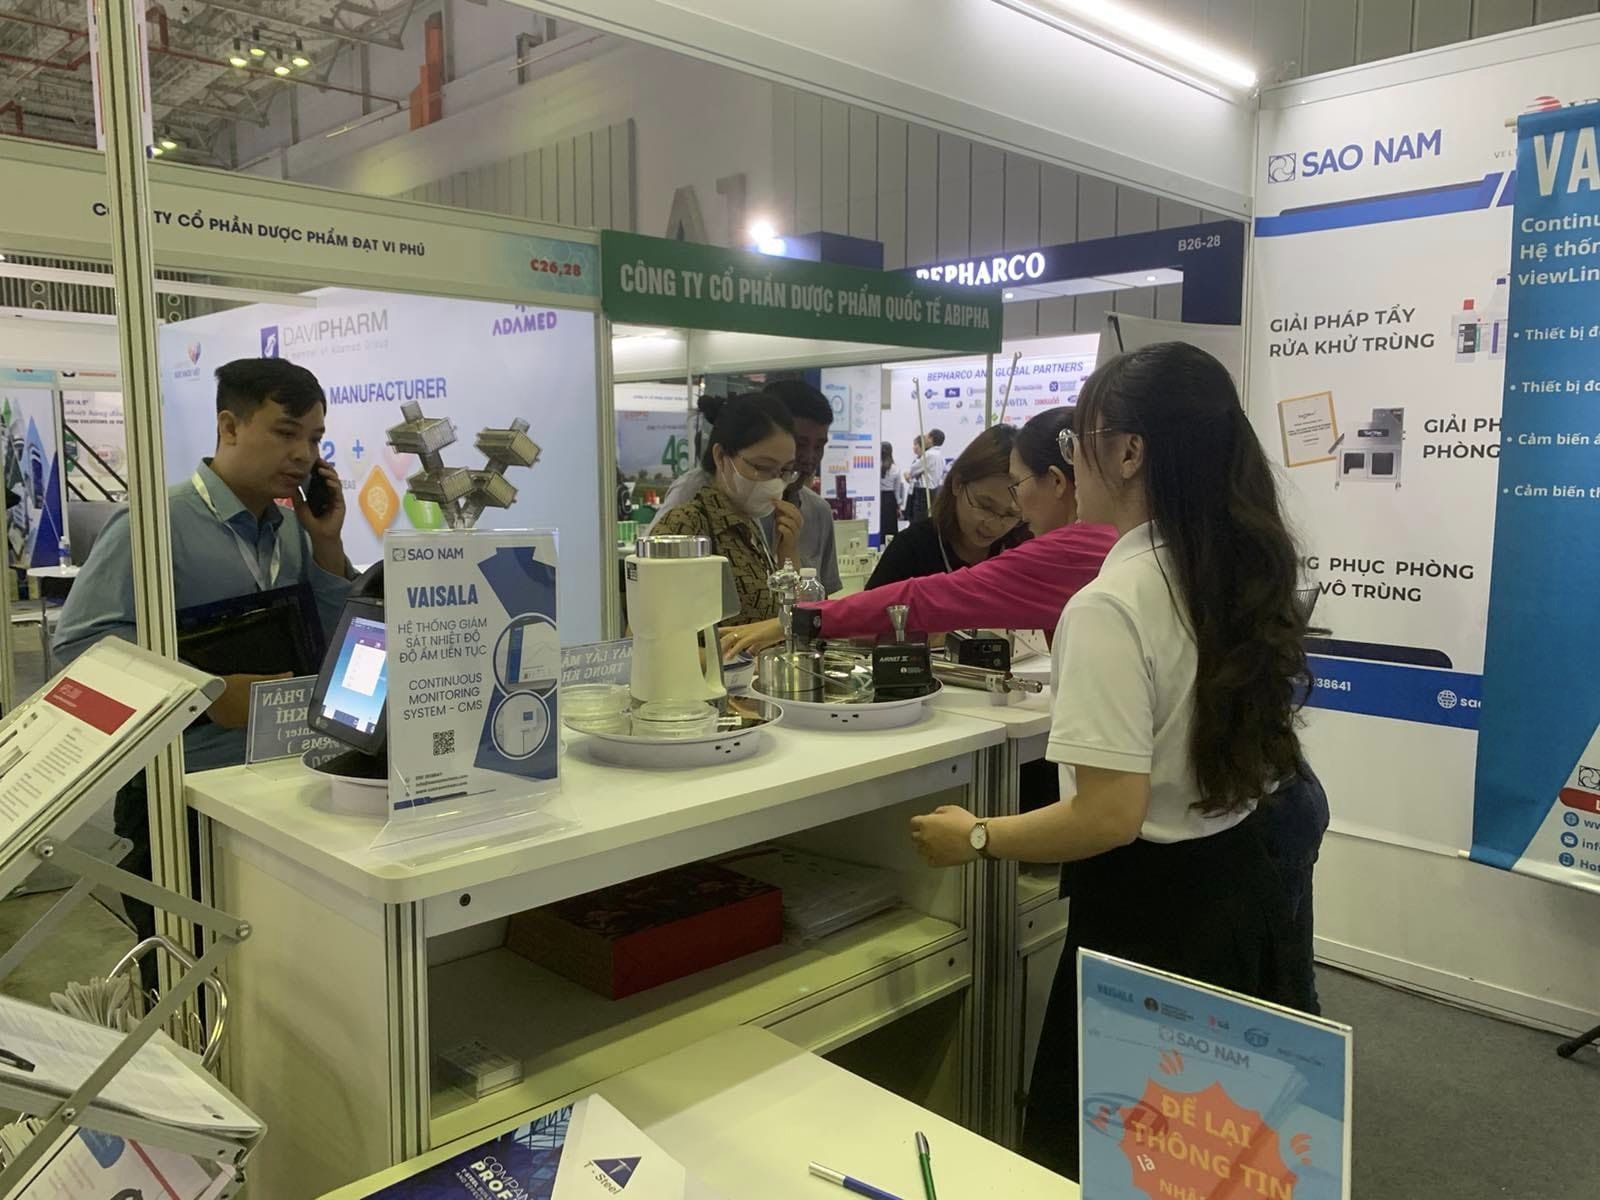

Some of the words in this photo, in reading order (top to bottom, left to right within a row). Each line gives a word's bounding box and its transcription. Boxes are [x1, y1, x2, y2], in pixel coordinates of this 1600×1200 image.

[1302, 143, 1363, 178] SAO
[1374, 129, 1441, 166] NAM
[154, 210, 172, 225] TY
[178, 209, 204, 228] CỔ
[209, 215, 253, 236] PHẦN
[258, 224, 302, 243] DƯỢC
[307, 227, 348, 247] PHẨM
[352, 235, 378, 253] ĐẠT
[382, 239, 396, 253] VI
[1178, 234, 1221, 252] B26-28
[1520, 243, 1548, 262] Hệ
[530, 258, 581, 277] C26,28
[620, 260, 676, 297] CÔNG
[682, 271, 703, 299] TY
[709, 266, 734, 303] CỔ
[739, 272, 786, 309] PHẦN
[791, 284, 833, 317] DƯỢC
[838, 284, 881, 318] PHẨM
[885, 291, 922, 323] QUỐC
[926, 296, 941, 324] TẾ
[944, 303, 990, 329] ABIPHA
[283, 309, 388, 346] DAVIPHARM
[1270, 312, 1308, 333] GIẢI
[1314, 309, 1369, 330] PHÁP
[1375, 304, 1415, 325] TẨY
[1525, 326, 1565, 341] Thiết
[1570, 326, 1584, 341] bị
[1588, 325, 1600, 338] đ
[1269, 337, 1309, 358] RỬA
[1314, 332, 1358, 355] KHỬ
[1362, 332, 1435, 353] TRÙNG
[927, 370, 972, 382] BEPHARCO
[975, 369, 988, 379] AN
[995, 367, 1030, 377] GLOBAL
[1033, 361, 1083, 374] PARTNERS
[330, 377, 447, 405] MANUFACTURER
[1522, 380, 1561, 393] Thiết
[1565, 380, 1580, 394] bị
[1424, 414, 1466, 434] GIẢI
[1474, 417, 1502, 433] PH
[1518, 433, 1551, 445] Cảm
[1556, 433, 1589, 445] biến
[1423, 441, 1500, 459] PHÒNG
[1514, 484, 1547, 497] Cảm
[1552, 484, 1585, 498] biến
[407, 548, 434, 561] SAO
[438, 547, 464, 560] NAM
[1329, 557, 1385, 576] PHỤC
[1395, 560, 1474, 580] PHÒNG
[407, 584, 478, 608] VAISALA
[1319, 579, 1346, 596] VÔ
[1352, 581, 1421, 602] TRÙNG
[398, 620, 413, 635] HỆ
[416, 619, 457, 633] THỐNG
[458, 617, 487, 629] GIÁM
[405, 635, 427, 648] SÁT
[466, 645, 488, 659] TỤC
[409, 672, 482, 691] CONTINUOUS
[1313, 678, 1351, 691] 38641
[409, 686, 480, 705] MONITORING
[403, 705, 446, 721] SYSTEM
[457, 700, 483, 713] CMS
[1176, 1033, 1209, 1055] SAO
[1215, 1046, 1249, 1069] NAM
[1160, 1094, 1197, 1126] ĐỂ
[1206, 1111, 1252, 1148] LẠI
[1131, 1120, 1231, 1180] THÔNG
[1240, 1163, 1293, 1200] TIN
[1136, 1154, 1156, 1172] là
[470, 1160, 516, 1200] PROF
[484, 1155, 531, 1200] COMPAN
[595, 1173, 622, 1195] Steel
